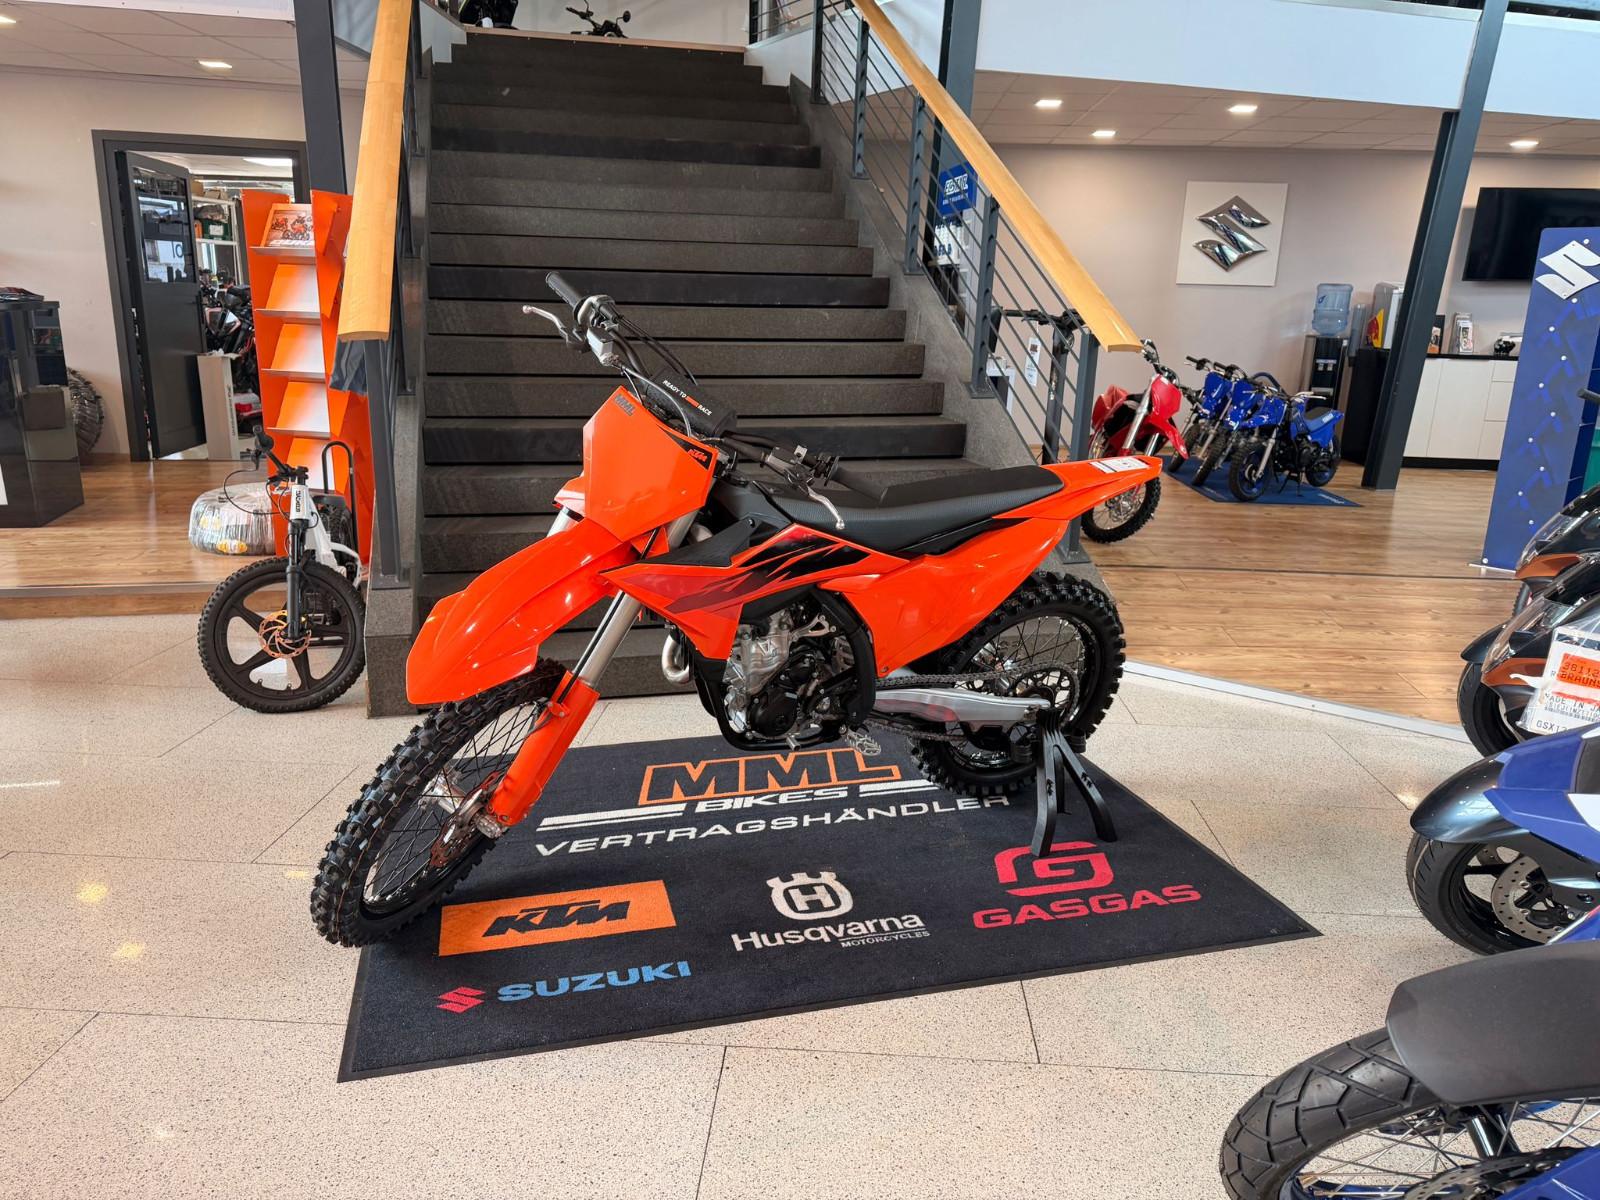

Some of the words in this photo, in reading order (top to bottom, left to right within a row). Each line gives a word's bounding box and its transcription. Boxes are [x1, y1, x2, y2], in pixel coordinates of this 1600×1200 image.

[662, 380, 680, 392] READY
[698, 405, 712, 416] RACE
[687, 449, 707, 462] KTM
[638, 749, 902, 806] MML
[695, 786, 848, 813] BIKES
[535, 795, 1011, 857] VERTRAGSHÄNDLER
[481, 899, 631, 938] KTM
[972, 884, 1202, 929] GASGAS
[731, 914, 926, 952] Husqvarna
[841, 930, 931, 949] MOTORCYCLES
[497, 960, 692, 1002] SUZUKI
